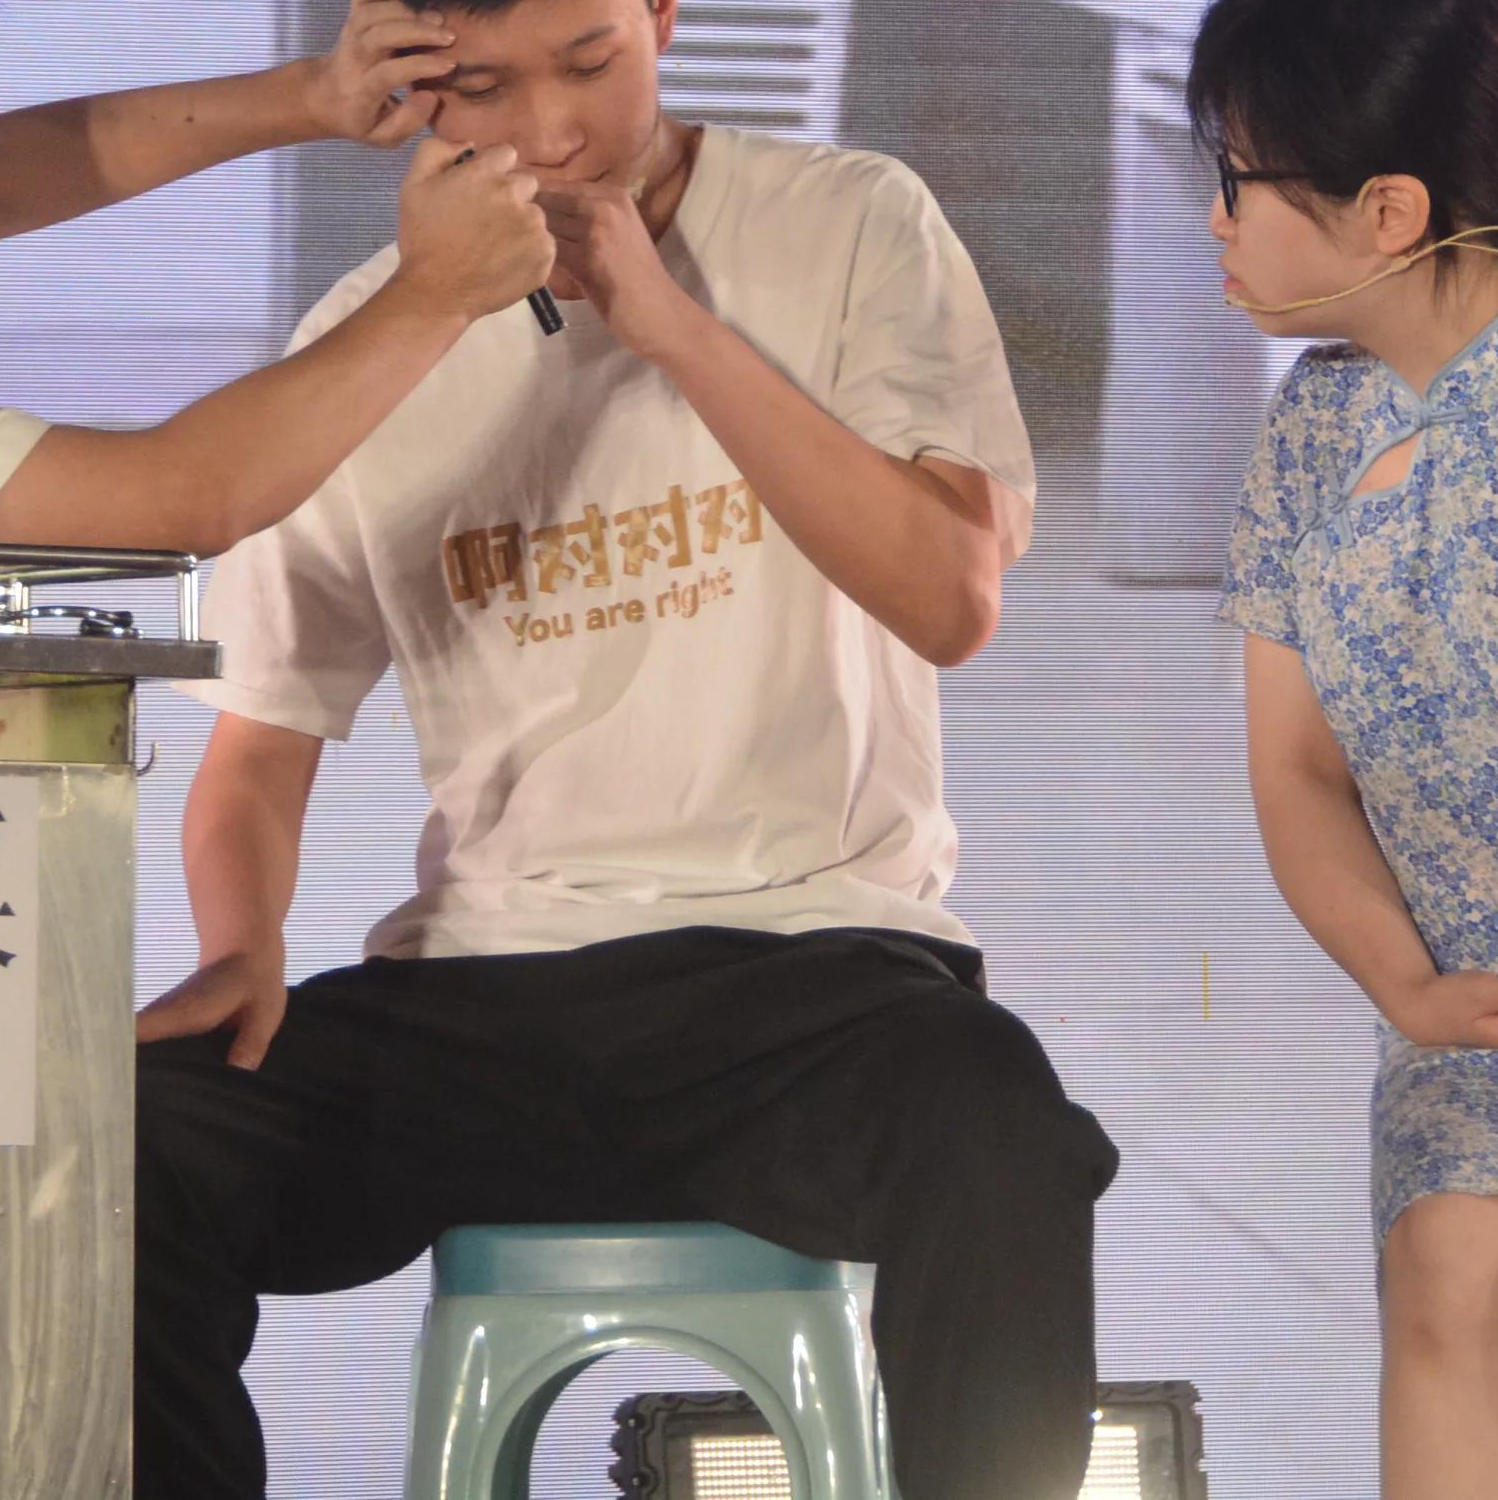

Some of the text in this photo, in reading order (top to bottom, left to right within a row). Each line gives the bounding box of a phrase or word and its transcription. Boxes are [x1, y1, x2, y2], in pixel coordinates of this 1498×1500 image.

[503, 566, 735, 647] You are right
